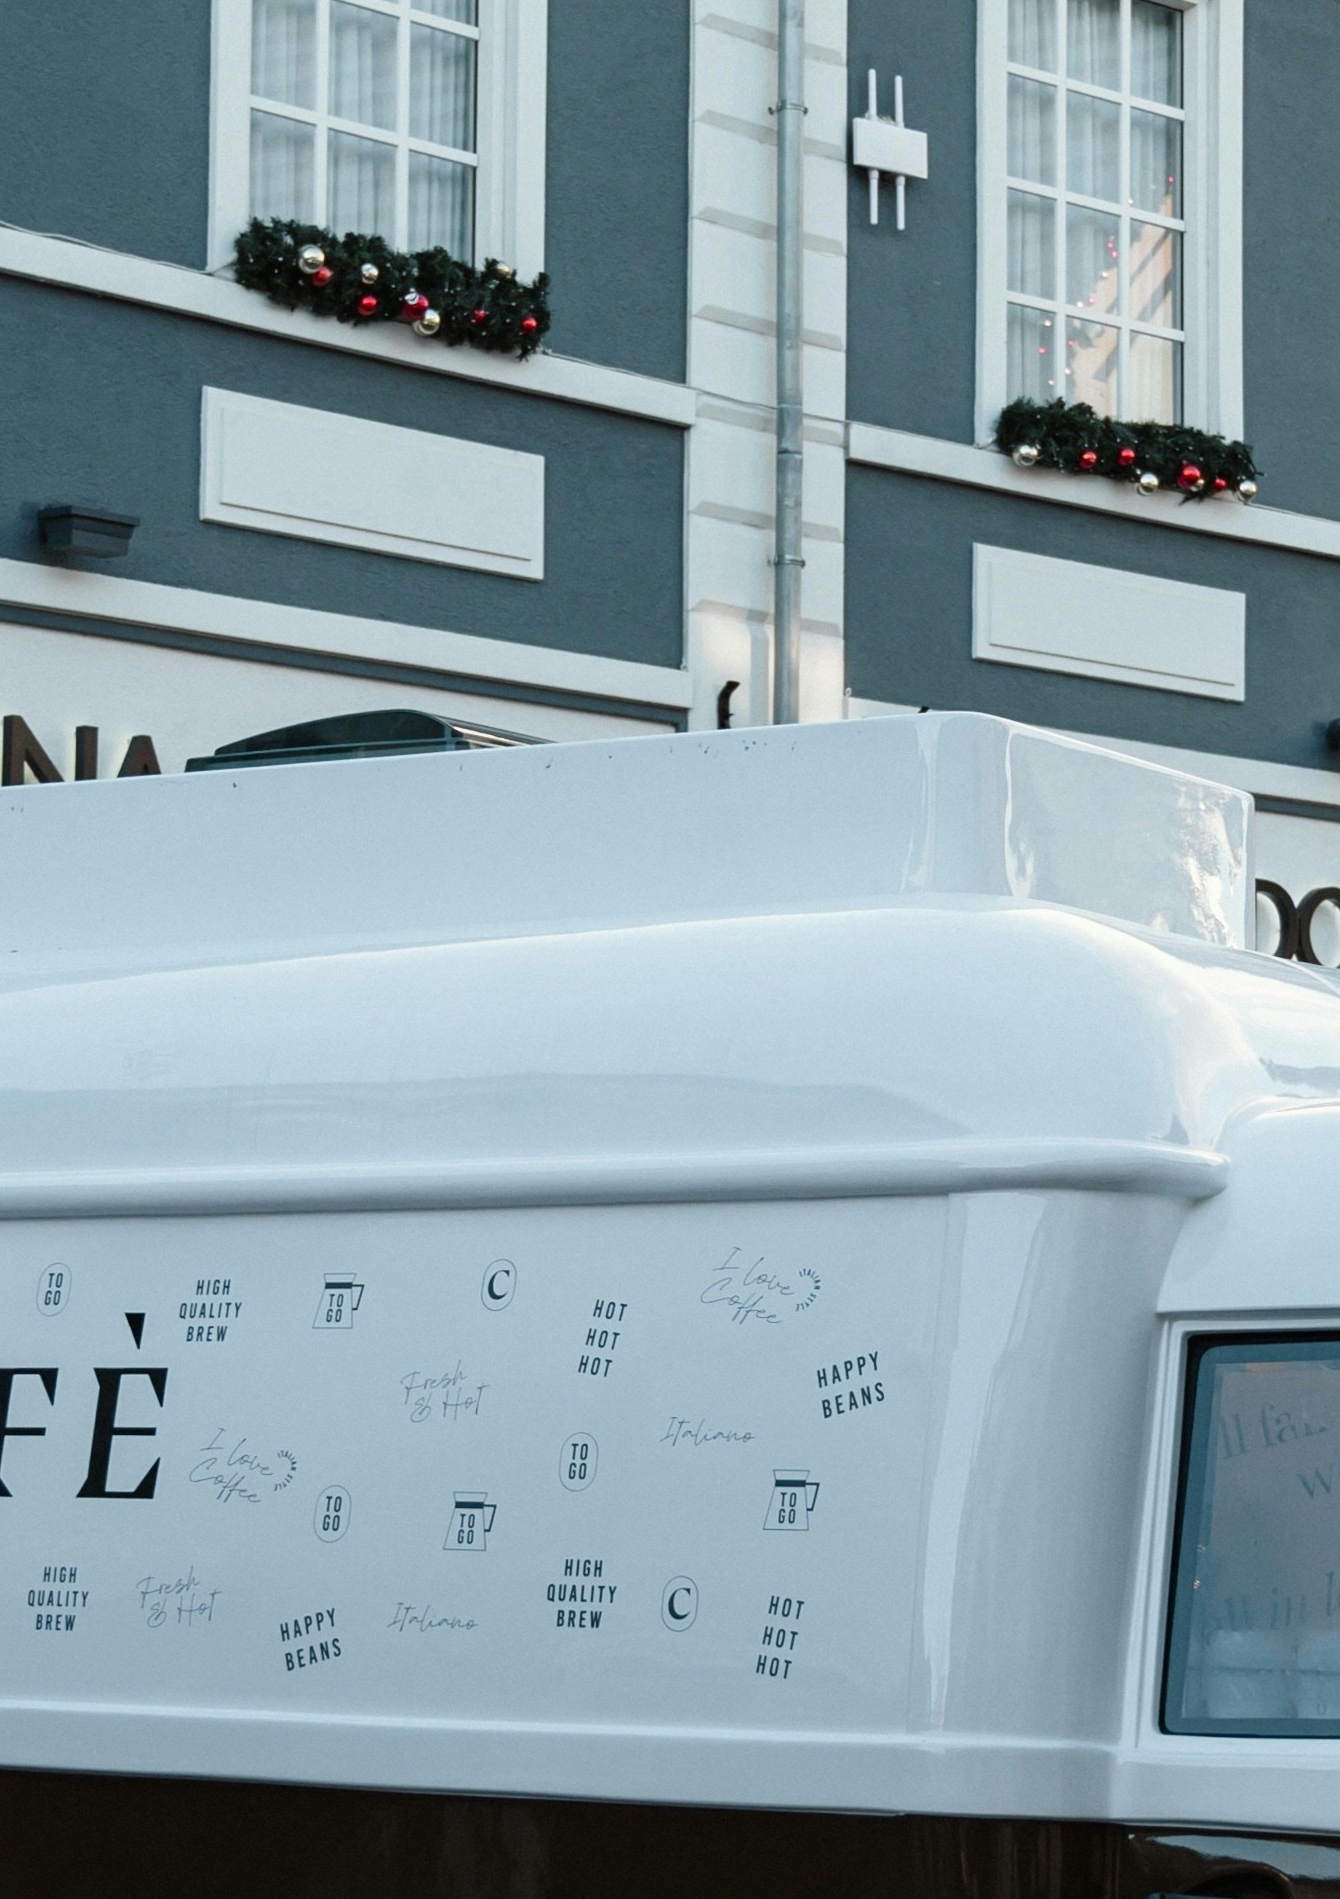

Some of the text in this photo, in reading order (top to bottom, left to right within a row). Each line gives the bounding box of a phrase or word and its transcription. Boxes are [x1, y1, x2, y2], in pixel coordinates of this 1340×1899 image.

[48, 1272, 64, 1289] TO
[712, 1246, 794, 1295] I love
[195, 1278, 232, 1296] HIGH
[487, 1269, 511, 1301] C
[43, 1289, 62, 1306] GO
[329, 1293, 345, 1308] TO
[700, 1277, 781, 1324] Coffee
[178, 1301, 243, 1320] QUALITY
[325, 1308, 343, 1323] GO
[592, 1298, 628, 1322] HOT
[185, 1325, 228, 1342] BREW
[585, 1327, 621, 1351] HOT
[577, 1354, 613, 1378] HOT
[817, 1351, 880, 1389] HAPPY
[400, 1359, 468, 1404] Fresh
[443, 1383, 490, 1420] Hot
[821, 1382, 886, 1419] BEANS
[659, 1415, 755, 1447] Italiano
[200, 1427, 274, 1475] I love
[571, 1443, 589, 1461] TO
[189, 1457, 262, 1503] Coffee
[568, 1462, 588, 1481] GO
[325, 1495, 343, 1513] TO
[780, 1491, 797, 1511] TO
[322, 1514, 341, 1532] GO
[460, 1514, 476, 1529] TO
[777, 1507, 797, 1525] GO
[457, 1528, 475, 1545] GO
[42, 1566, 78, 1584] HIGH
[564, 1558, 604, 1578] HIGH
[27, 1589, 90, 1608] QUALITY
[135, 1565, 200, 1609] Fresh
[546, 1583, 618, 1604] QUALITY
[177, 1588, 222, 1627] Hot
[667, 1587, 691, 1621] C
[767, 1595, 805, 1620] HOT
[35, 1613, 76, 1632] BREW
[280, 1607, 336, 1642] HAPPY
[387, 1602, 478, 1634] Italiano
[556, 1609, 603, 1629] BREW
[761, 1625, 799, 1651] HOT
[285, 1638, 342, 1671] BEANS
[755, 1654, 793, 1680] HOT
